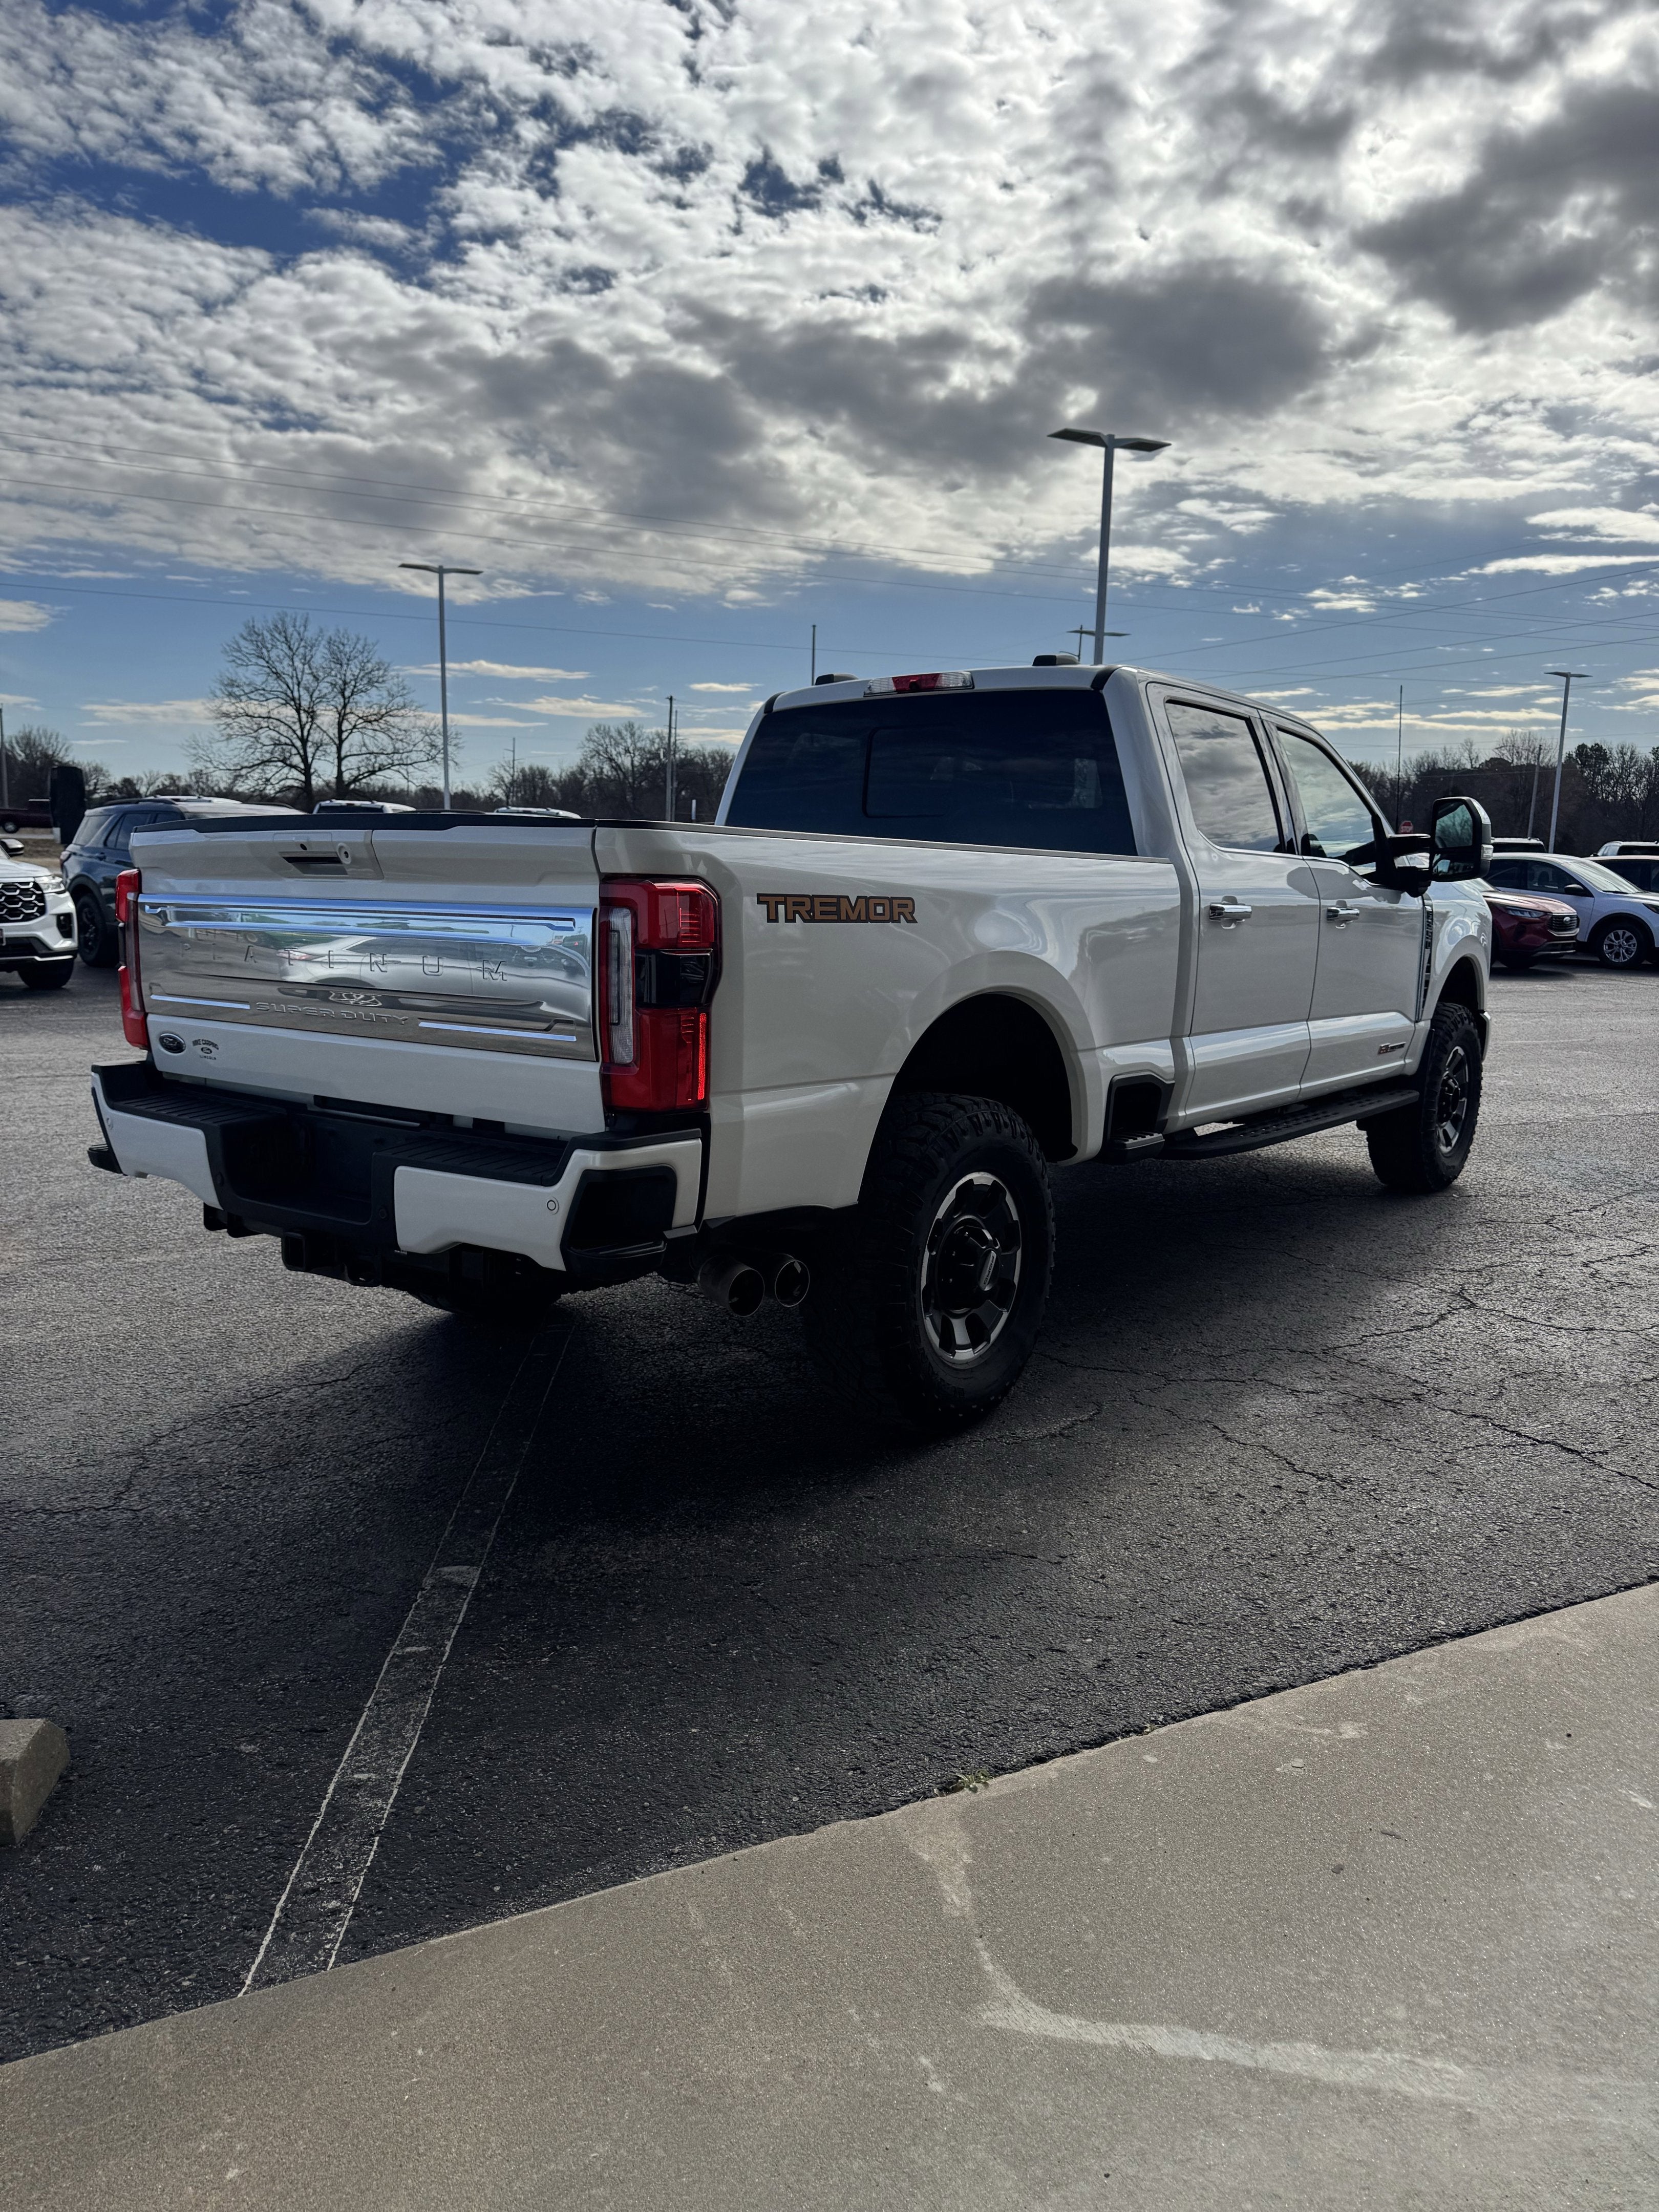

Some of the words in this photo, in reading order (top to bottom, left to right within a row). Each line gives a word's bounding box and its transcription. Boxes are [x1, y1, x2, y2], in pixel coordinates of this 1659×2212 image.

[756, 893, 918, 923] TREMOR
[181, 943, 507, 982] PLATINUM
[256, 1002, 335, 1018] SUPER
[341, 1010, 409, 1026] DUTY
[983, 1256, 994, 1285] FORD
